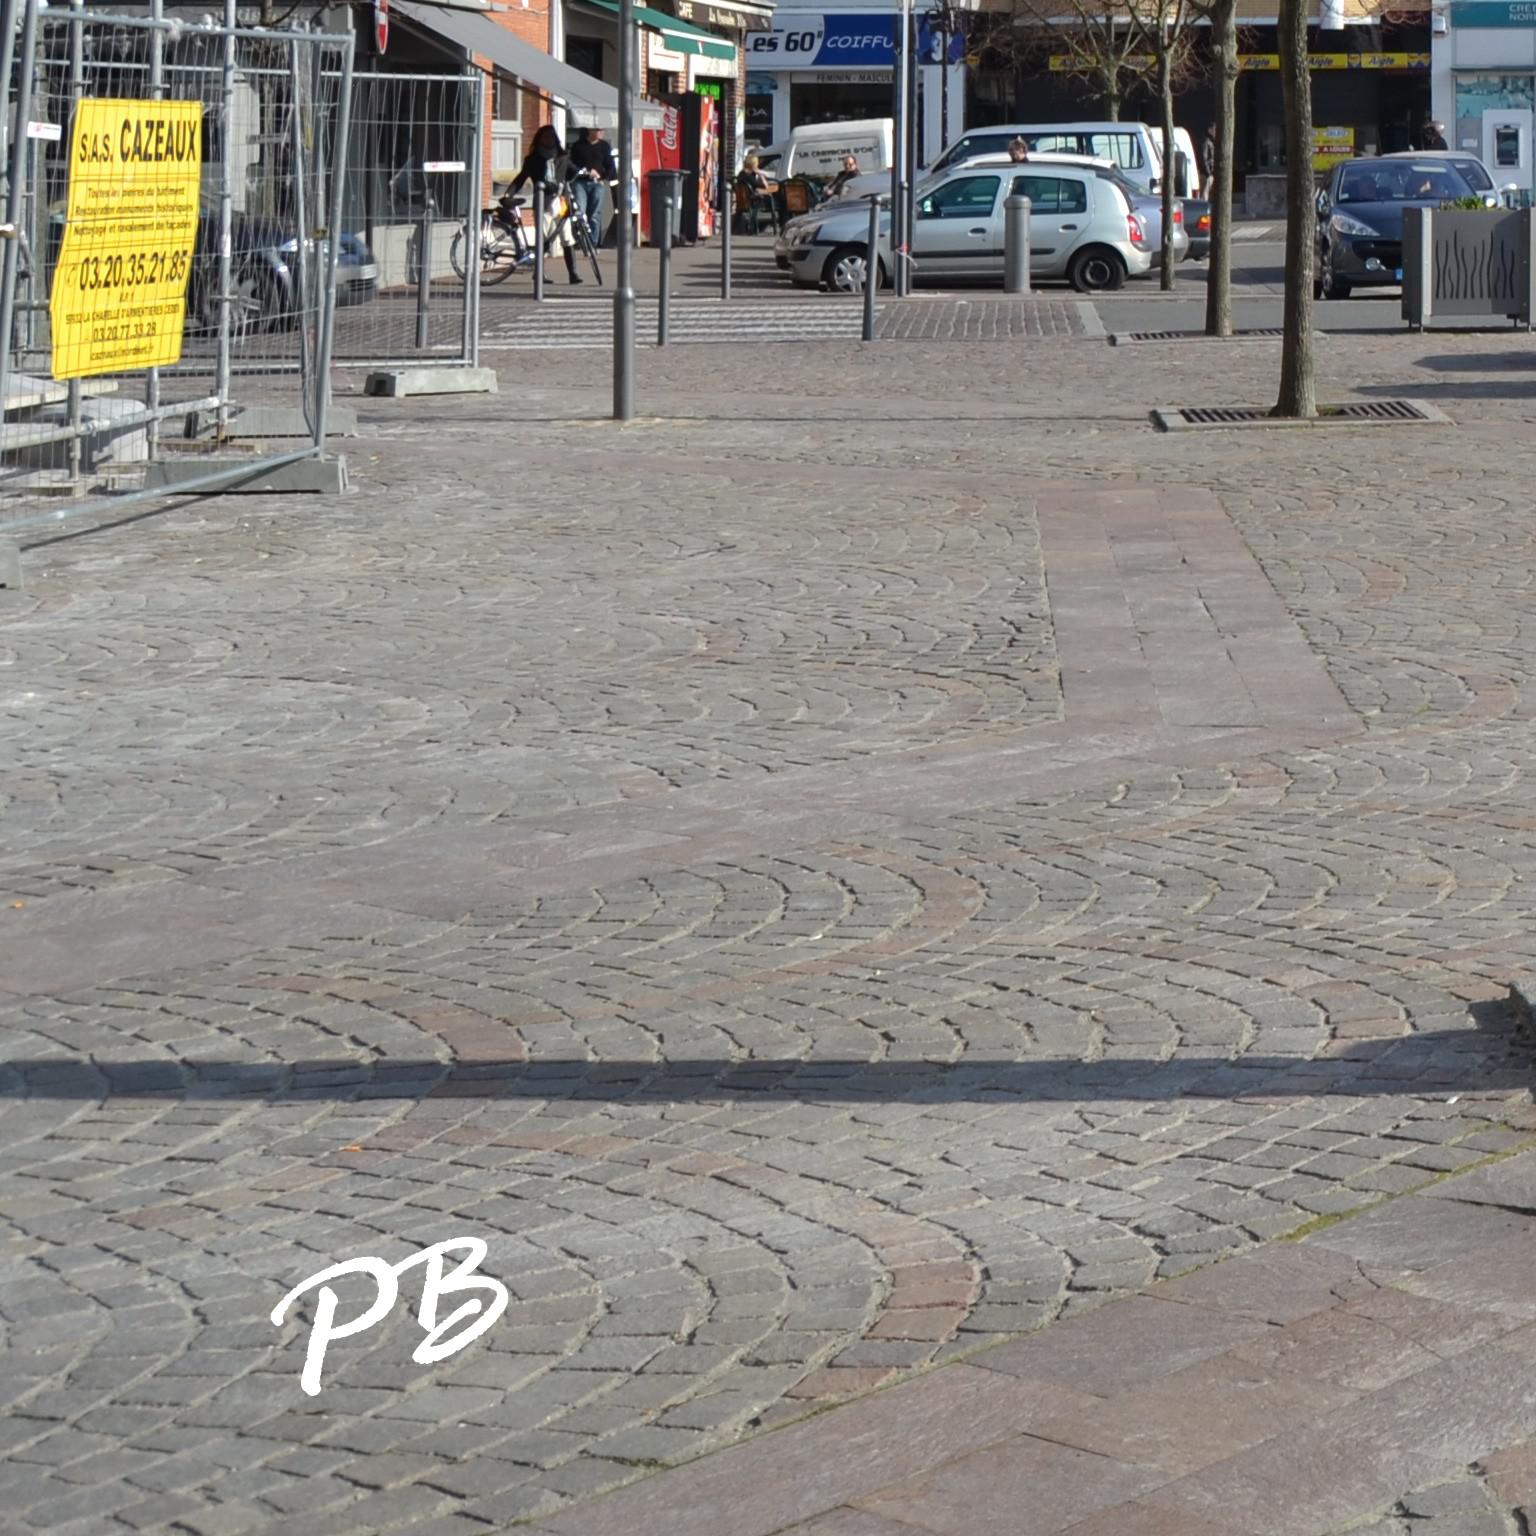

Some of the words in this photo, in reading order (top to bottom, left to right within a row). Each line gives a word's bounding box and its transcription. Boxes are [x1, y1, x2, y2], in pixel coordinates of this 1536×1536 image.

[826, 35, 894, 49] COIFFU
[79, 133, 114, 163] S.A.S.
[120, 118, 198, 163] CAZEAUX
